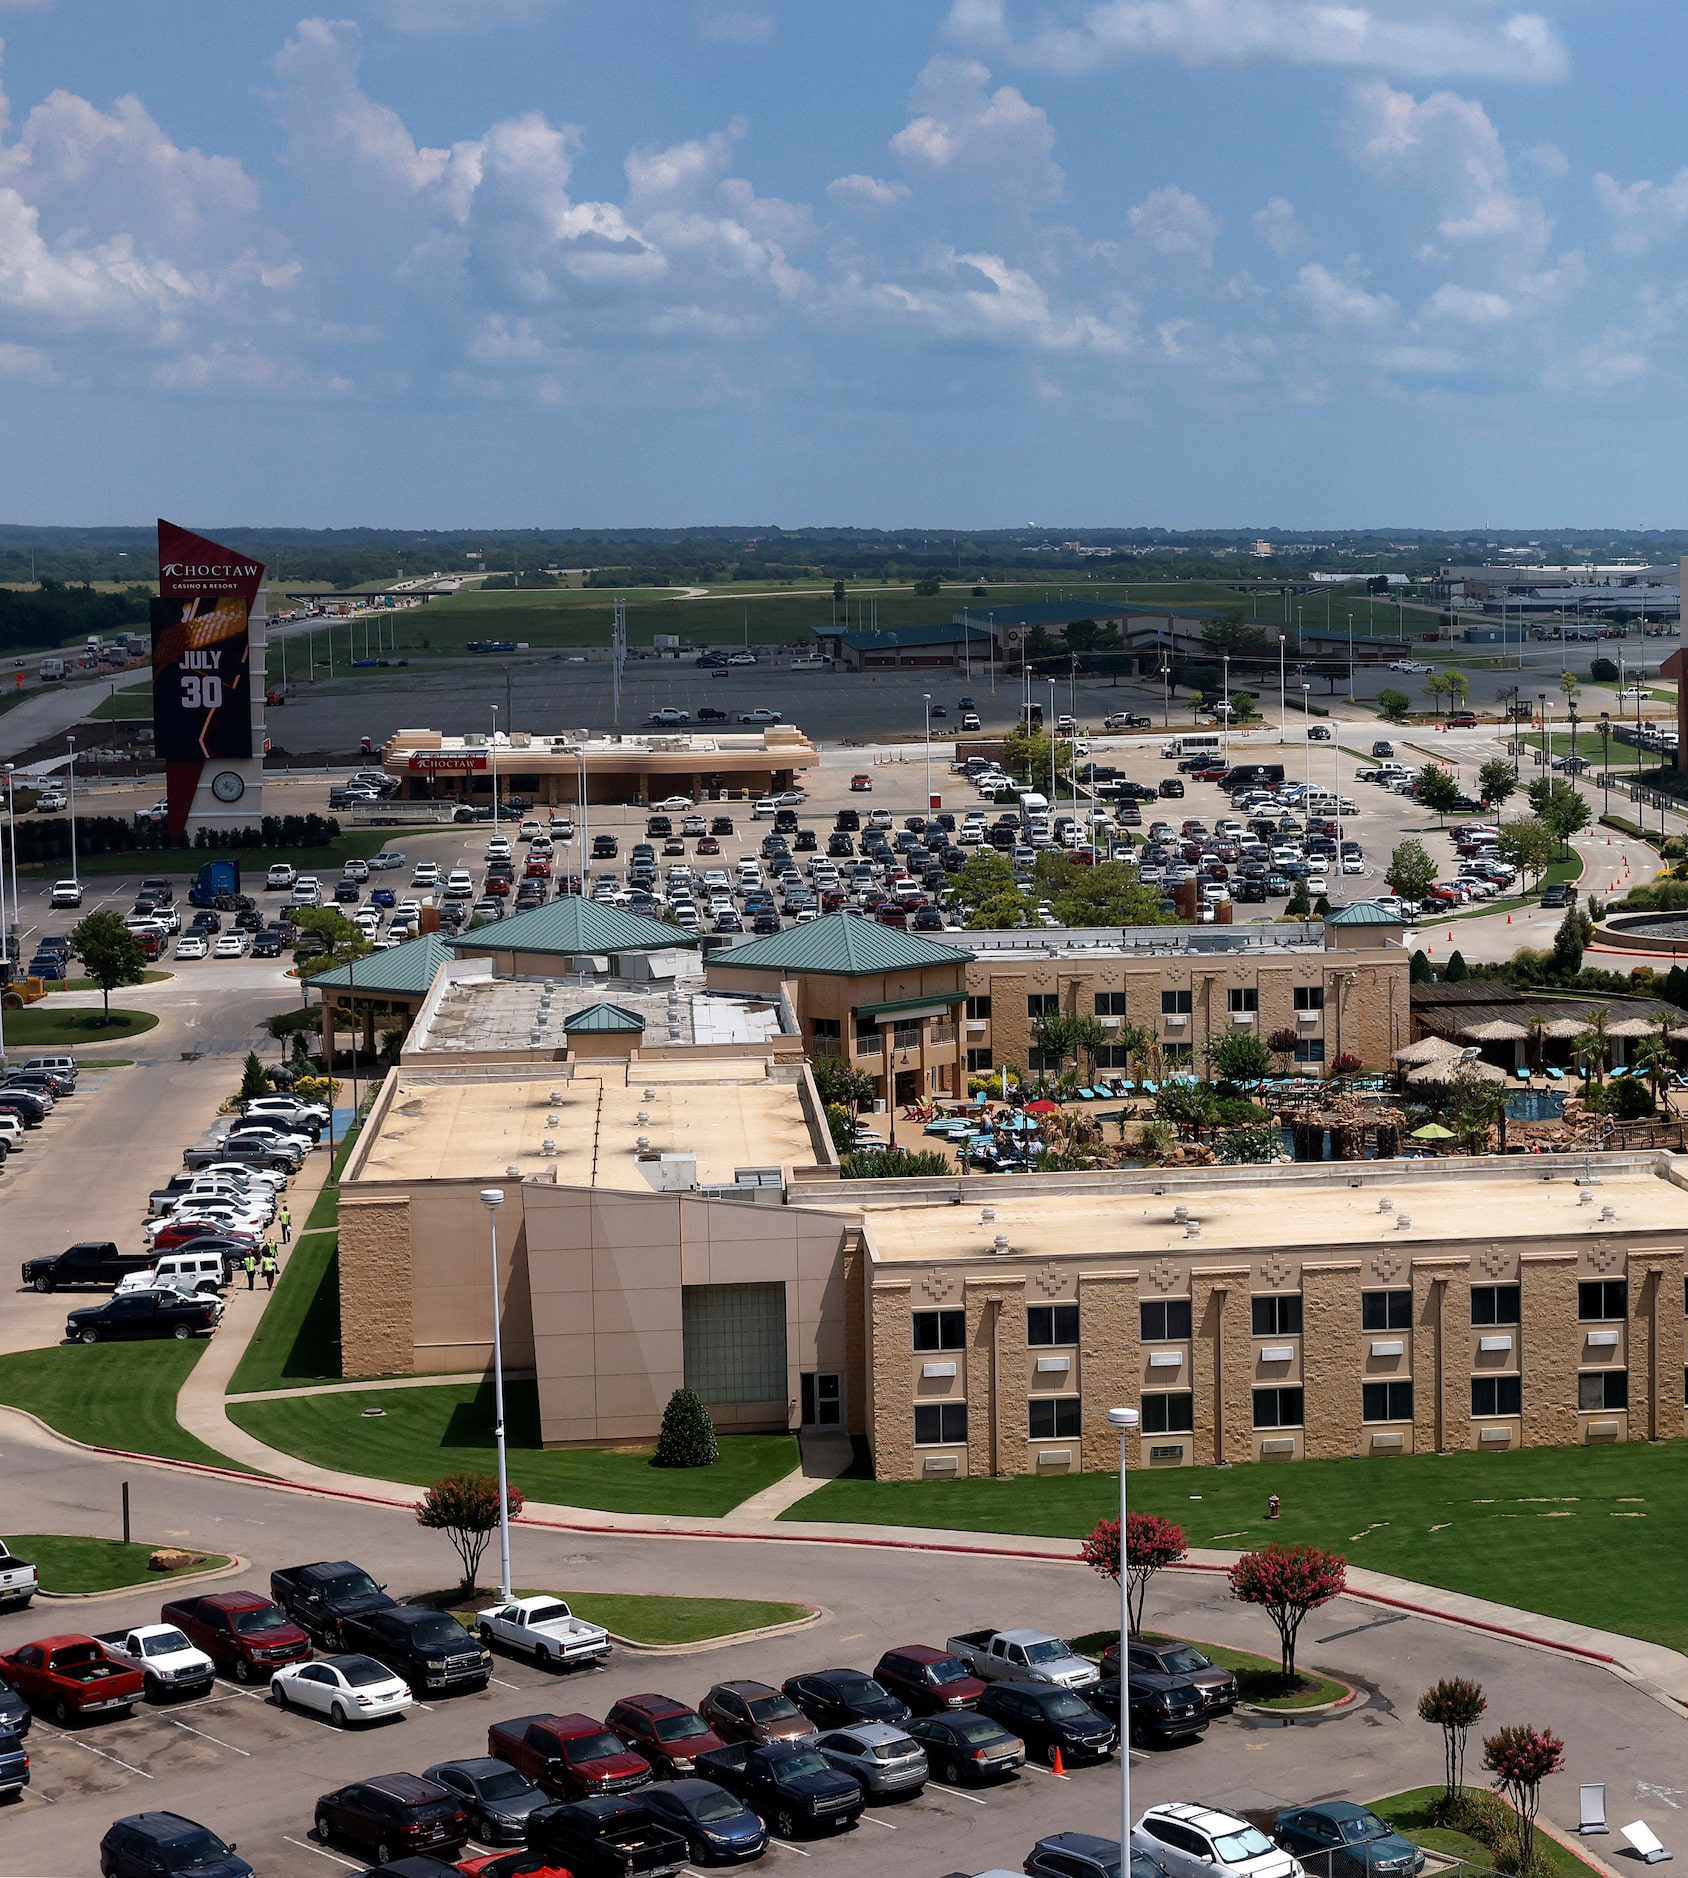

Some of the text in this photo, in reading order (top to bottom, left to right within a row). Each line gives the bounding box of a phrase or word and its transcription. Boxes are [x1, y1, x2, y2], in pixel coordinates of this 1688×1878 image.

[171, 563, 258, 576] CHOCTAW
[179, 650, 222, 670] JULY
[181, 675, 222, 709] 30
[423, 759, 474, 768] CHOCTAW
